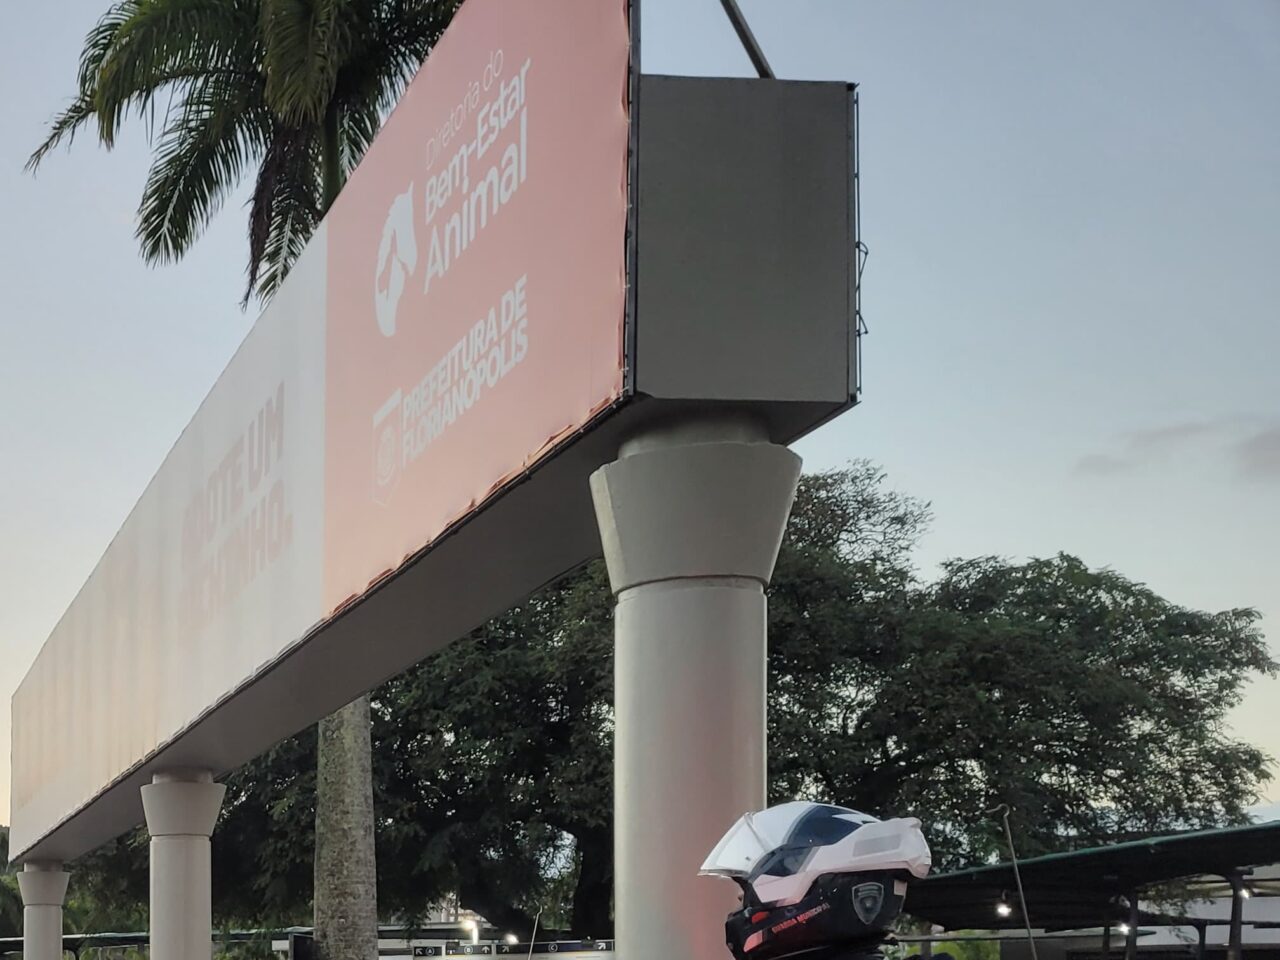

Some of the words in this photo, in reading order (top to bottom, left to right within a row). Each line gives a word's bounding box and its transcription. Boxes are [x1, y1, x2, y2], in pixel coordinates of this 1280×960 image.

[425, 57, 531, 226] Bem-Estar
[426, 81, 480, 171] Diretoria
[483, 49, 504, 92] do
[423, 105, 528, 296] Animal
[402, 306, 498, 431] PREFEITURA
[500, 273, 528, 336] DE
